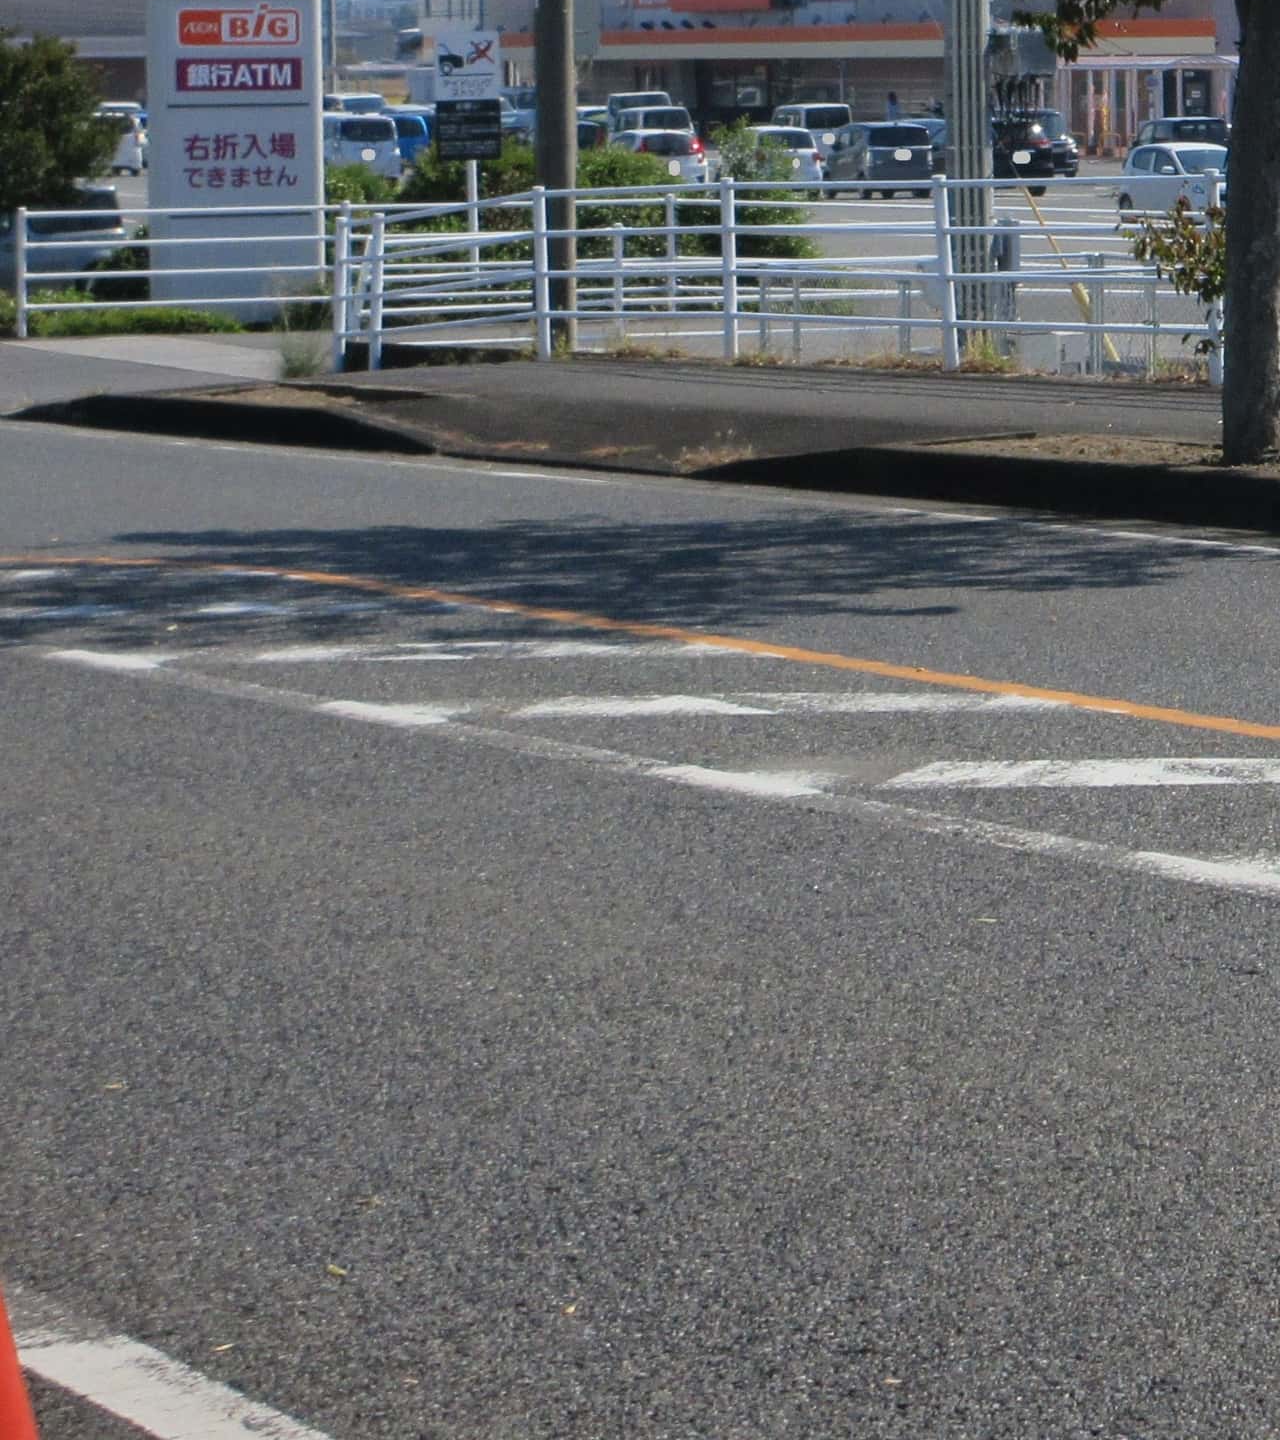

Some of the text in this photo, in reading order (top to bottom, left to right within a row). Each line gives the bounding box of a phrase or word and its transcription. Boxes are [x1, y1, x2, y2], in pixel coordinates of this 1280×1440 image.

[187, 63, 292, 88] 銀行ATM
[184, 133, 297, 161] 右折入場
[183, 166, 298, 189] できません
